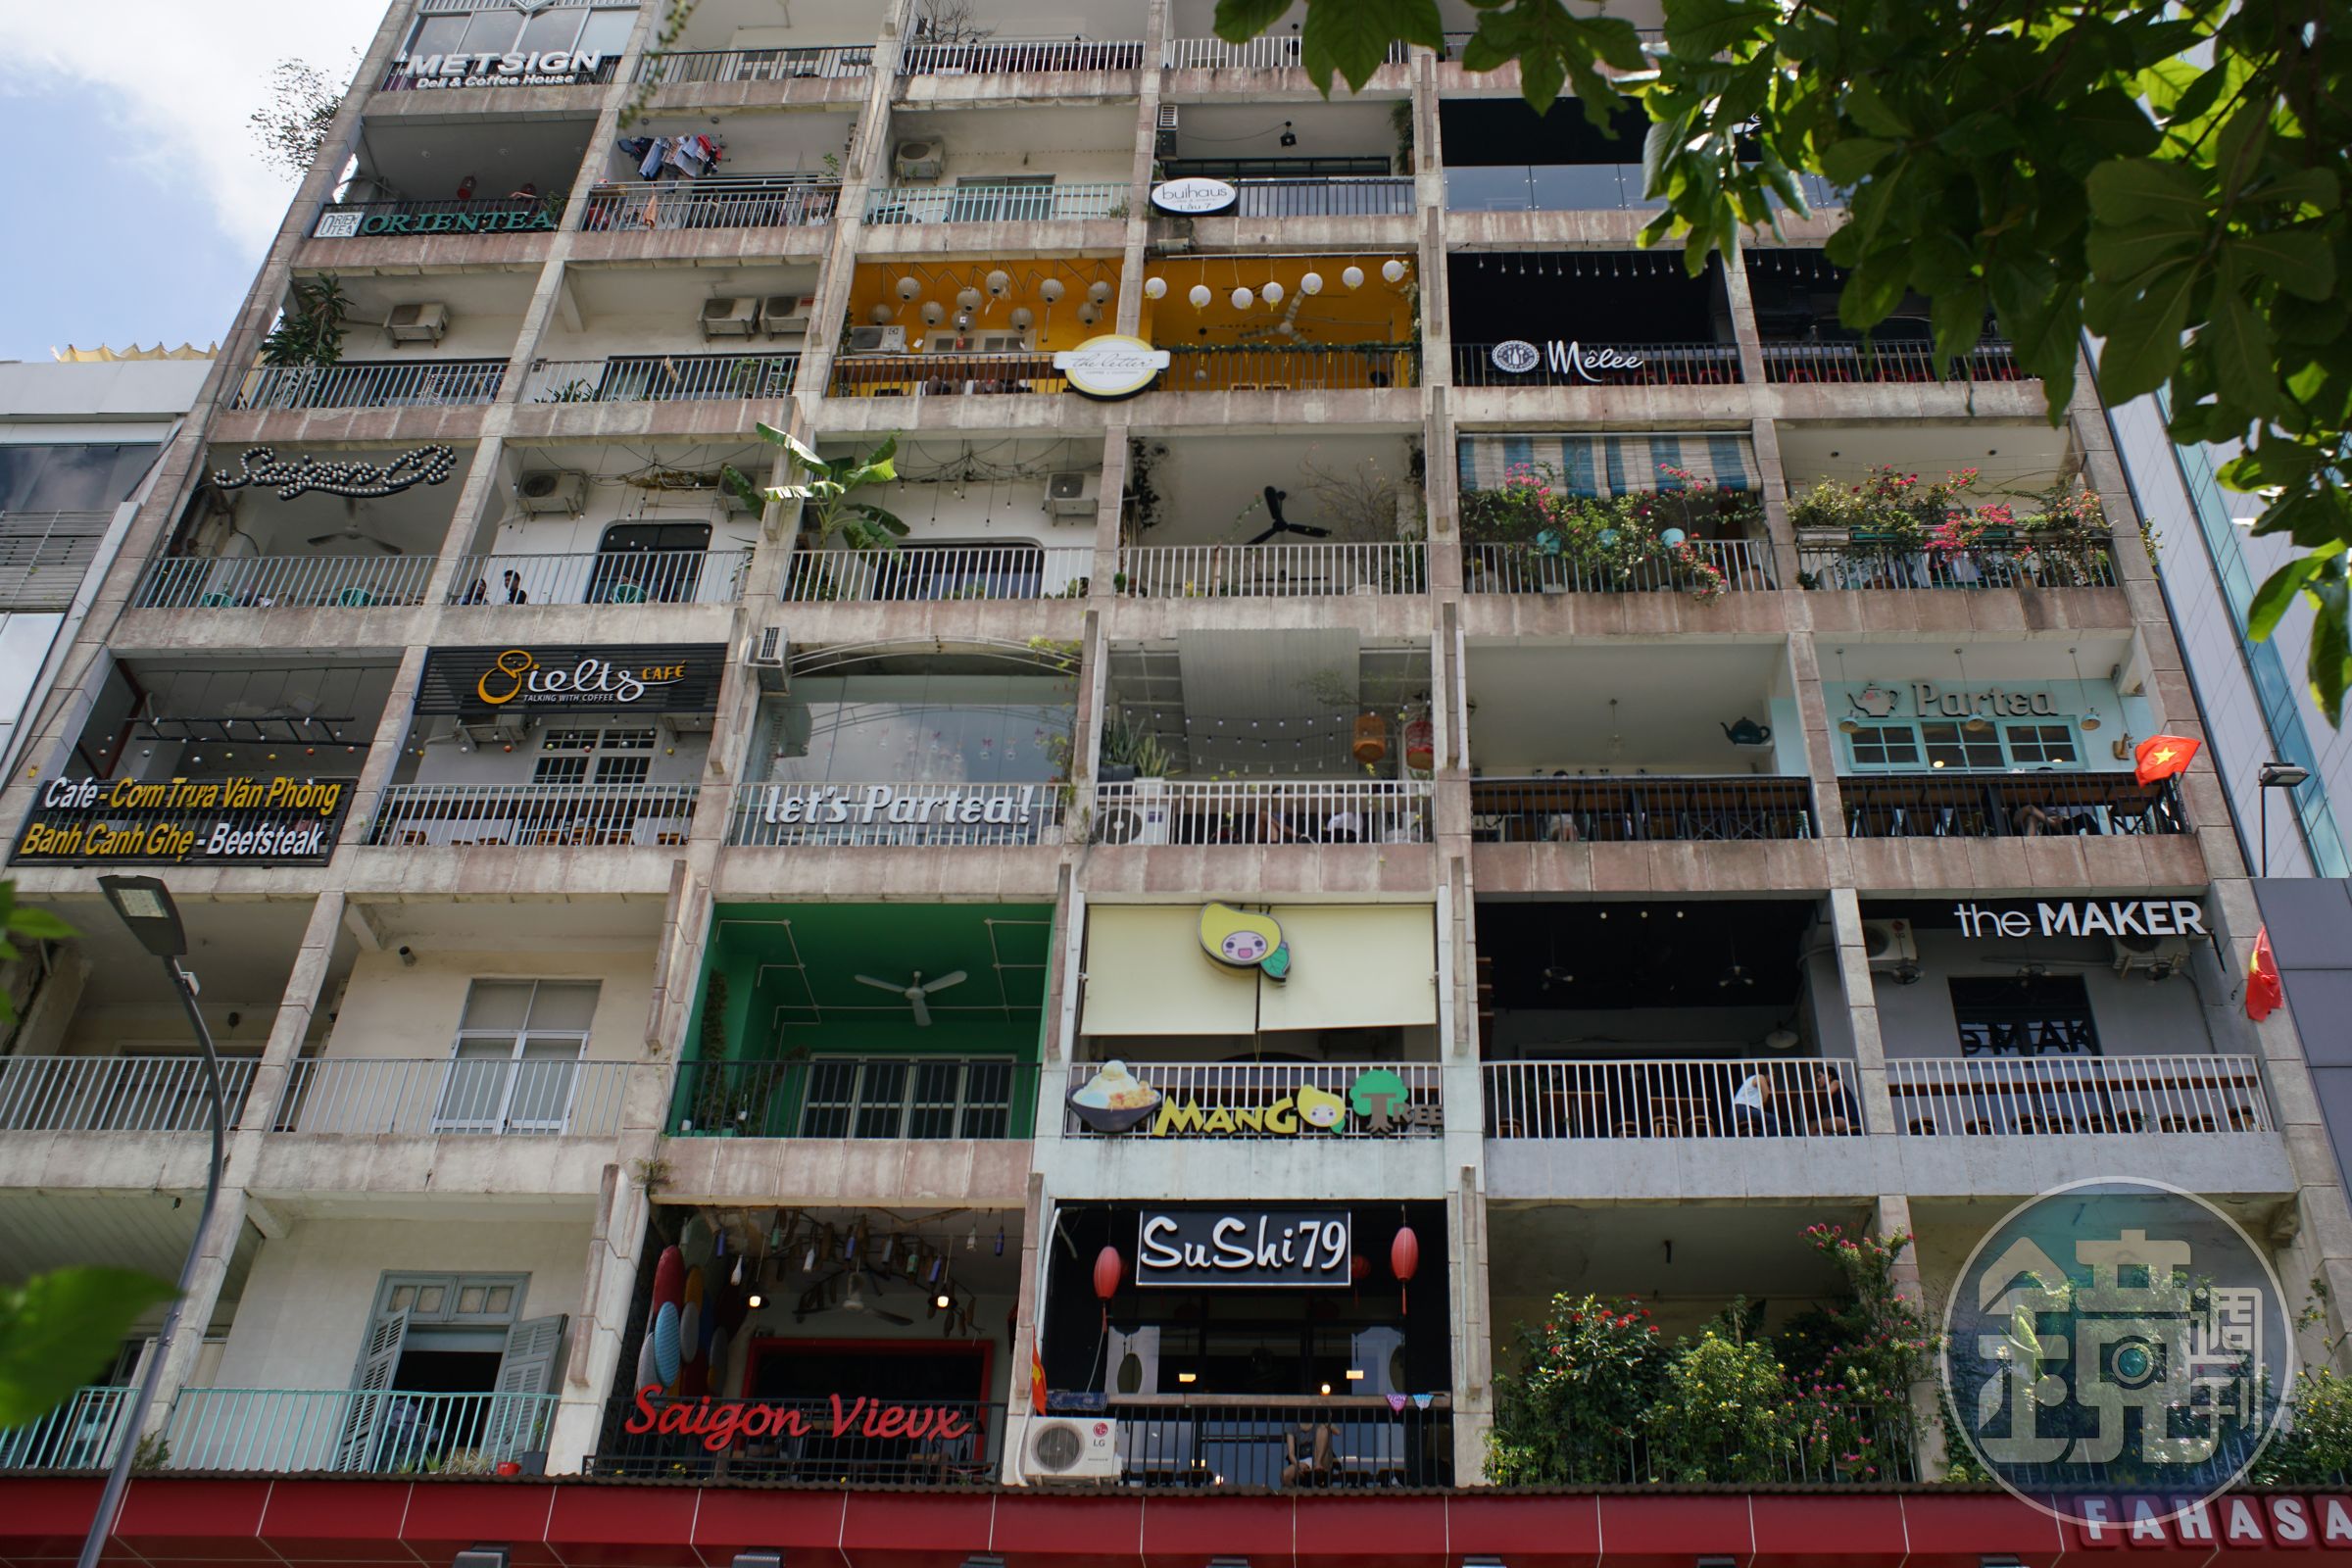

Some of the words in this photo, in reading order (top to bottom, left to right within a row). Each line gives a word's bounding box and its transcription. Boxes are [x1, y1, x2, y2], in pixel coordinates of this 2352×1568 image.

[405, 49, 602, 77] METSIGN
[416, 78, 447, 89] Deli
[449, 77, 462, 87] &
[465, 74, 519, 87] Coffee
[522, 74, 574, 85] House
[1162, 183, 1228, 200] buihaus
[362, 211, 555, 234] ORIENTEA
[1547, 340, 1643, 382] Mêlee
[642, 660, 686, 680] CAFÉ
[1912, 682, 2059, 716] Partea
[222, 776, 265, 808] Văn
[764, 785, 850, 824] let's
[862, 785, 1035, 824] Partea!
[85, 822, 146, 855] Canh
[147, 822, 194, 862] Ghẹ
[206, 822, 325, 855] Beefsteak
[1953, 903, 2032, 937] the
[2036, 901, 2208, 937] MAKER
[625, 1383, 812, 1451] Saigon
[829, 1394, 971, 1441] Vieux
[2083, 1498, 2352, 1541] FAHASA
